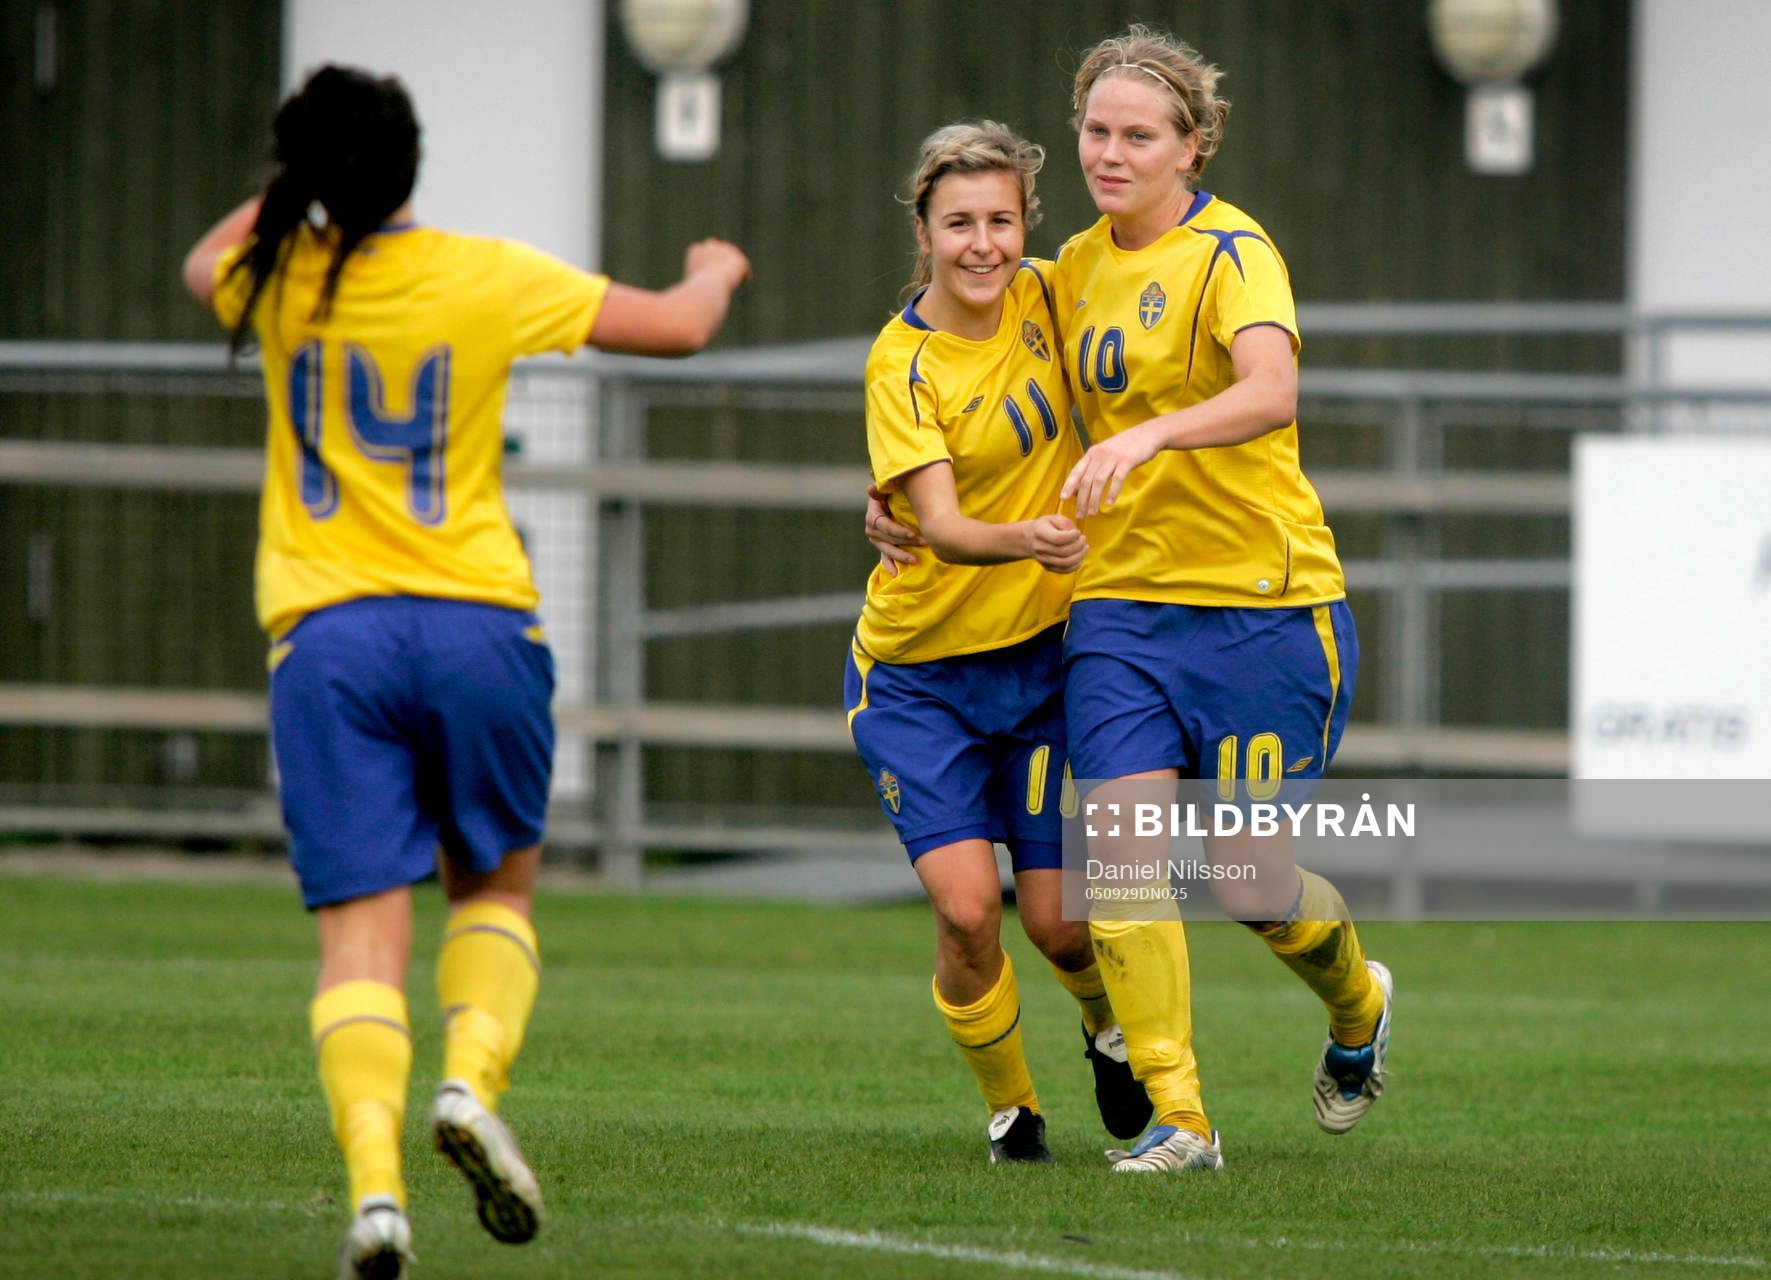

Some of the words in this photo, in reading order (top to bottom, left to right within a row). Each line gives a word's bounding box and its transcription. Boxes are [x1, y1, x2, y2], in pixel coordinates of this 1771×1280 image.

[1078, 326, 1129, 393] 10
[288, 337, 453, 527] 14
[1003, 378, 1058, 457] 11
[1217, 732, 1283, 802] 10
